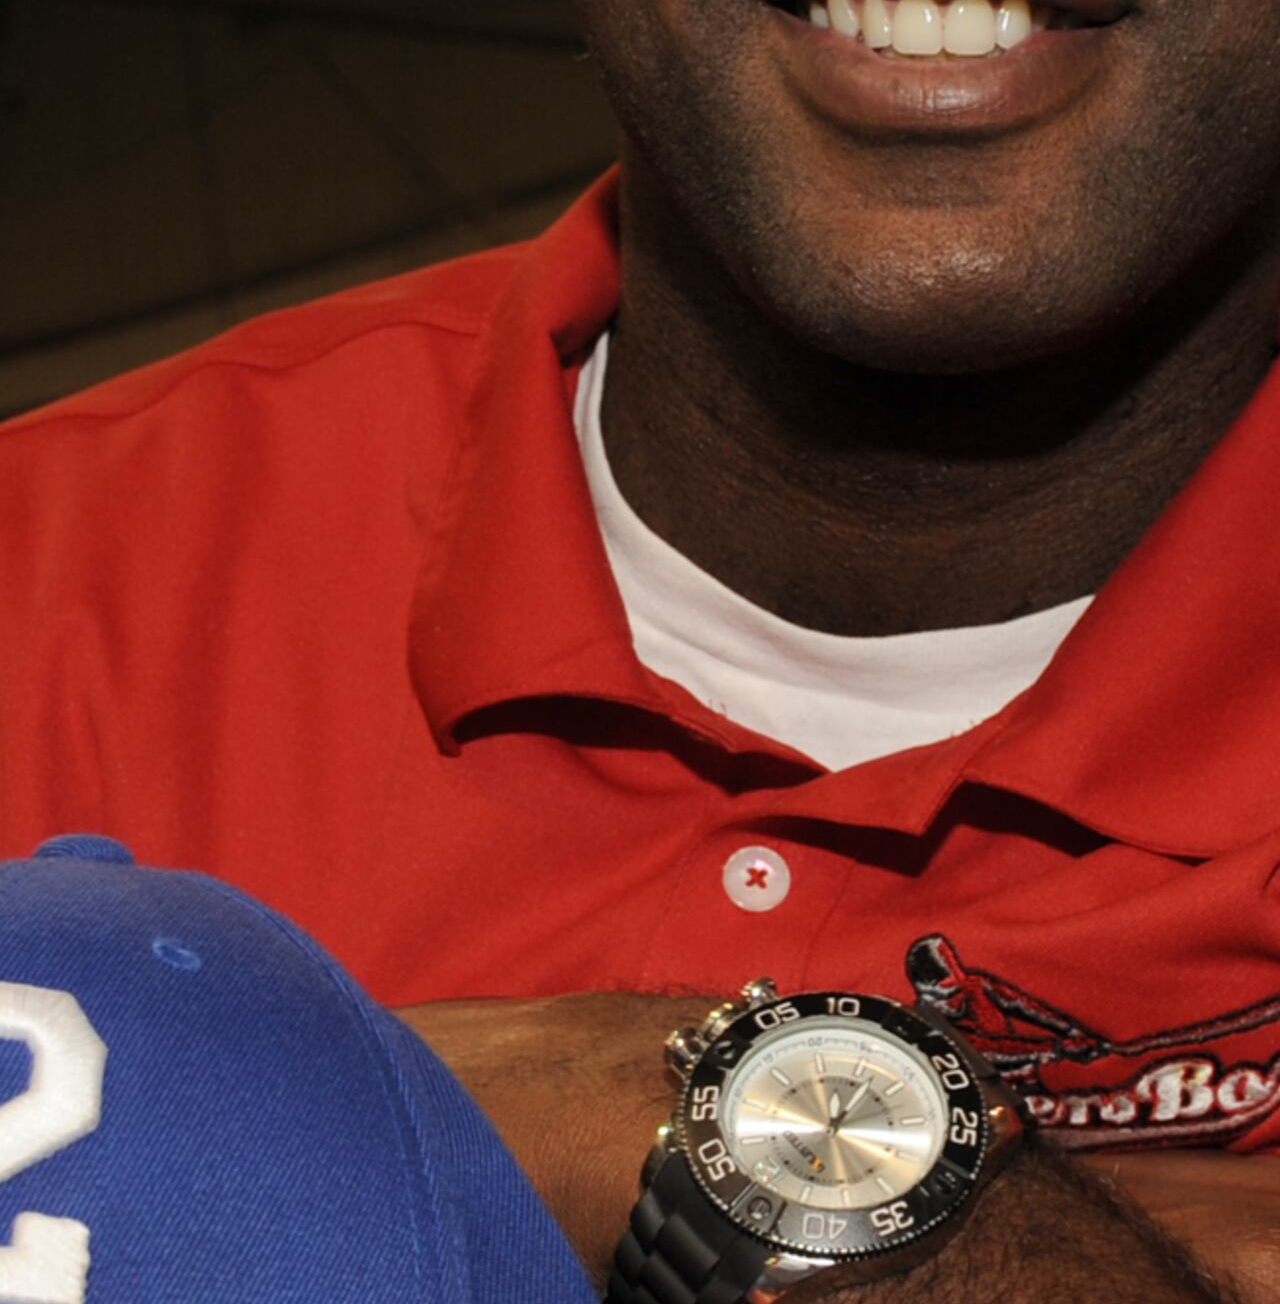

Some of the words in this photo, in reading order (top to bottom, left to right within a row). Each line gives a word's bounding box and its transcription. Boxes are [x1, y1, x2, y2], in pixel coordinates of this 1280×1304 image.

[755, 1001, 801, 1031] 05
[826, 996, 860, 1017] 10
[931, 1052, 970, 1091] 20
[692, 1085, 719, 1122] 55
[950, 1106, 979, 1146] 25
[697, 1137, 736, 1181] 50
[802, 1213, 848, 1240] 40
[870, 1201, 914, 1237] 35
